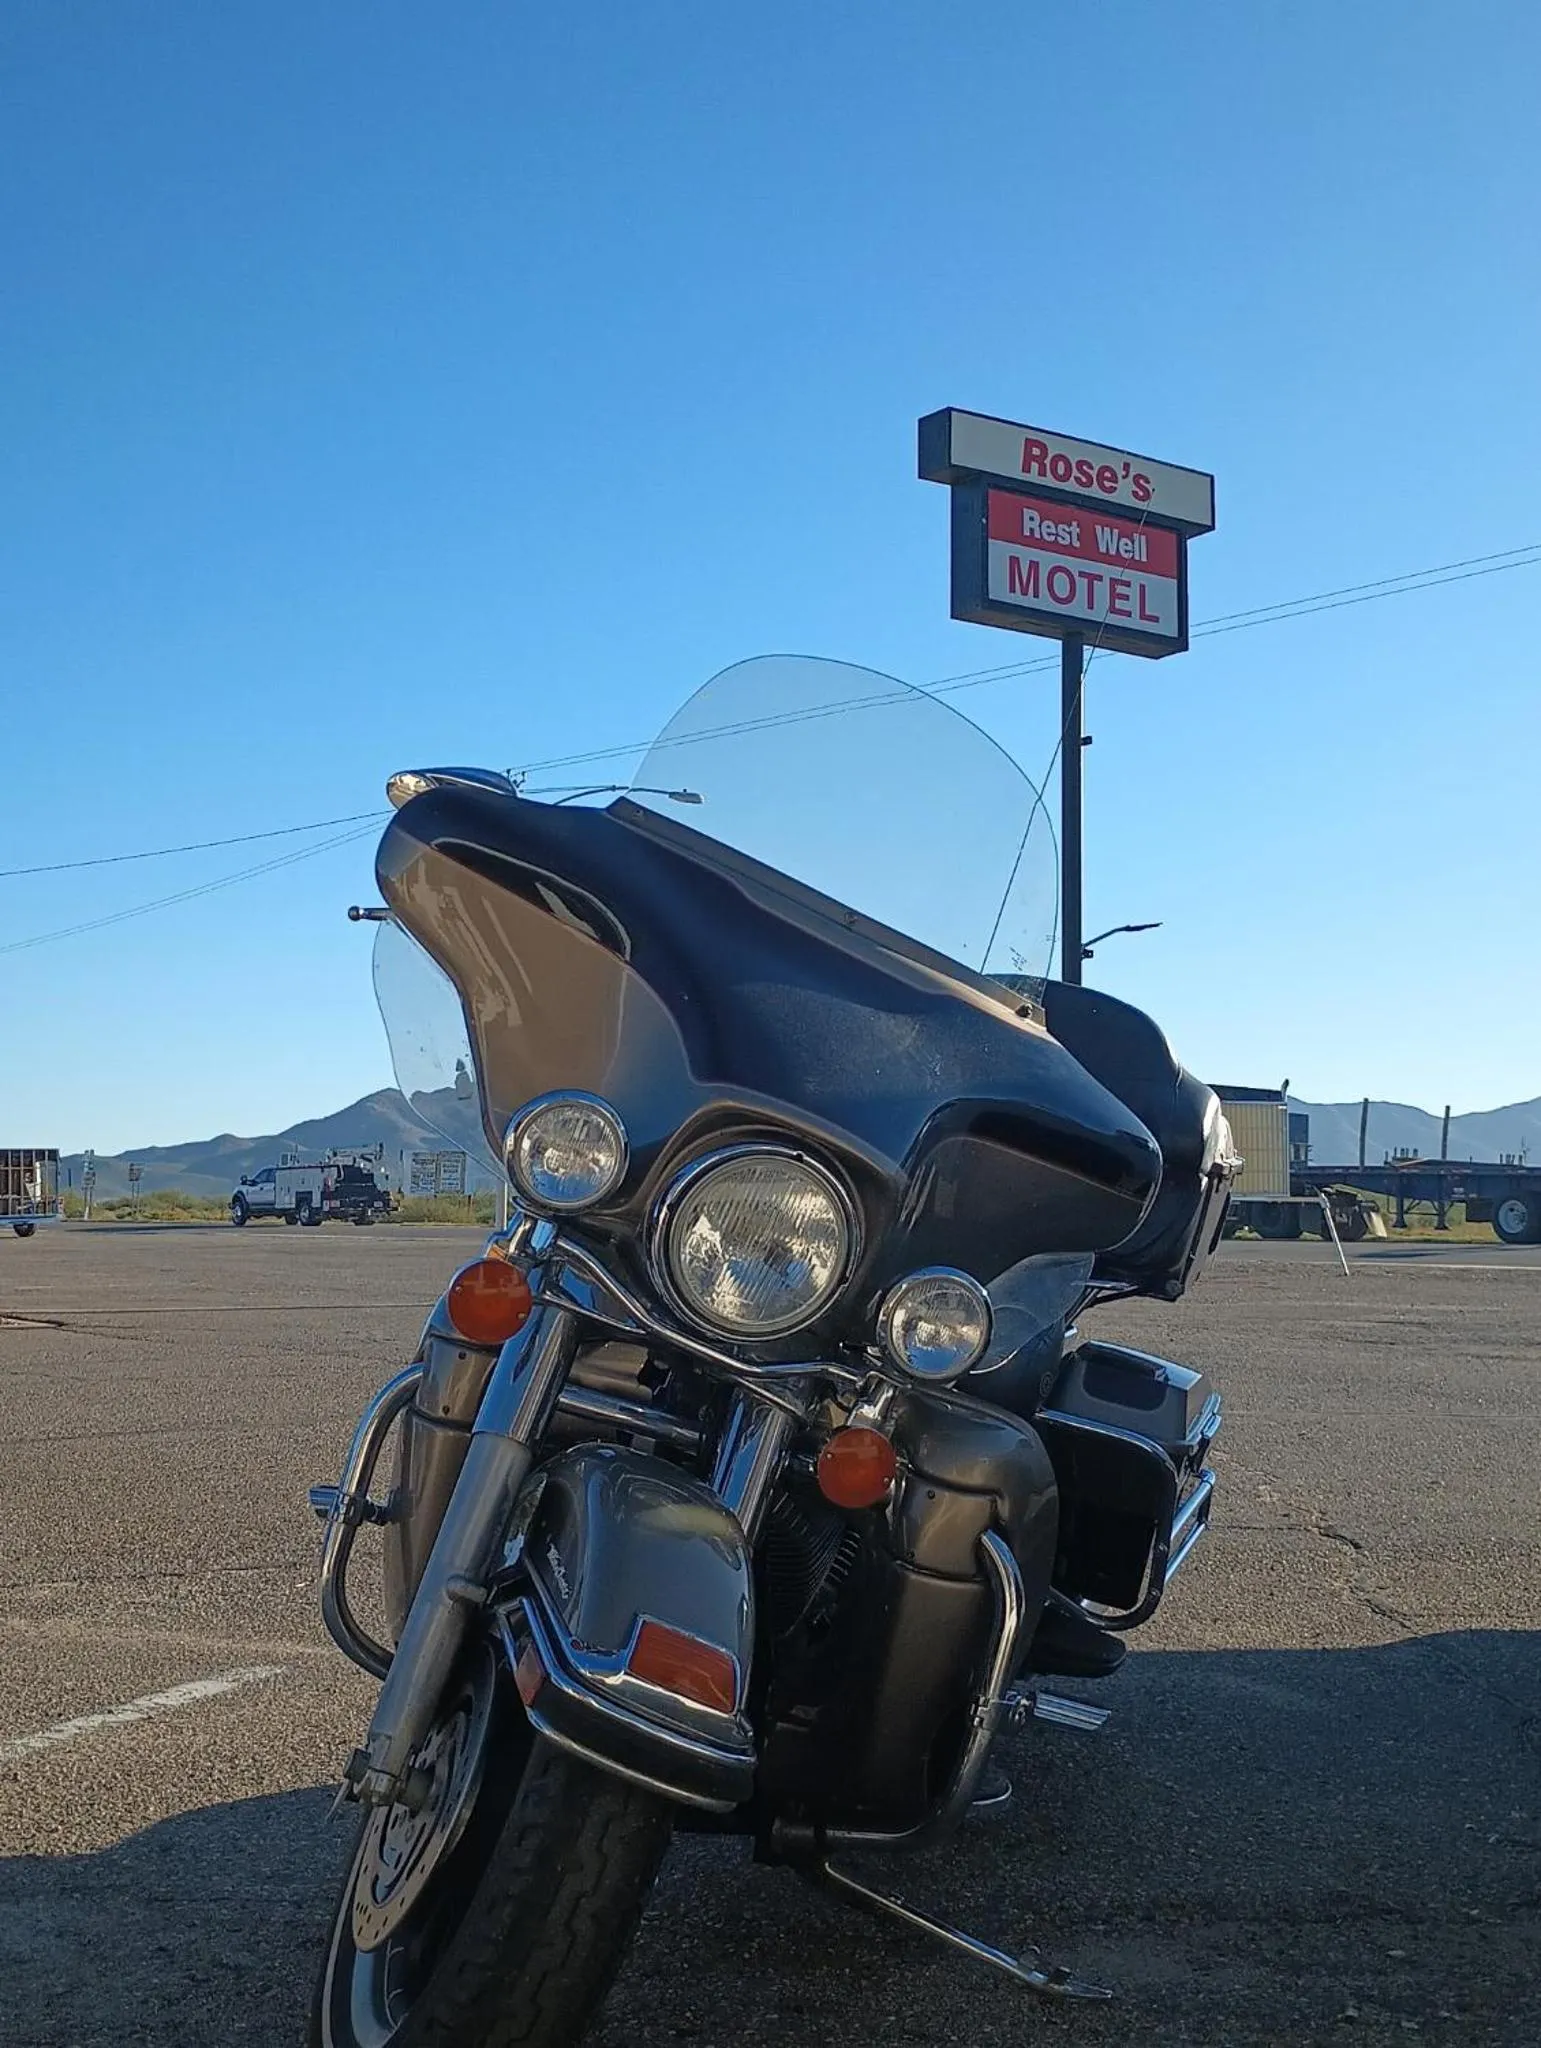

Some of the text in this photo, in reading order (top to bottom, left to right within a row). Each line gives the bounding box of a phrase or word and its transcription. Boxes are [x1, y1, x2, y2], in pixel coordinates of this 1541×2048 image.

[1021, 438, 1152, 502] Rose's
[1022, 508, 1147, 562] Rest Well
[1009, 556, 1160, 623] MOTEL
